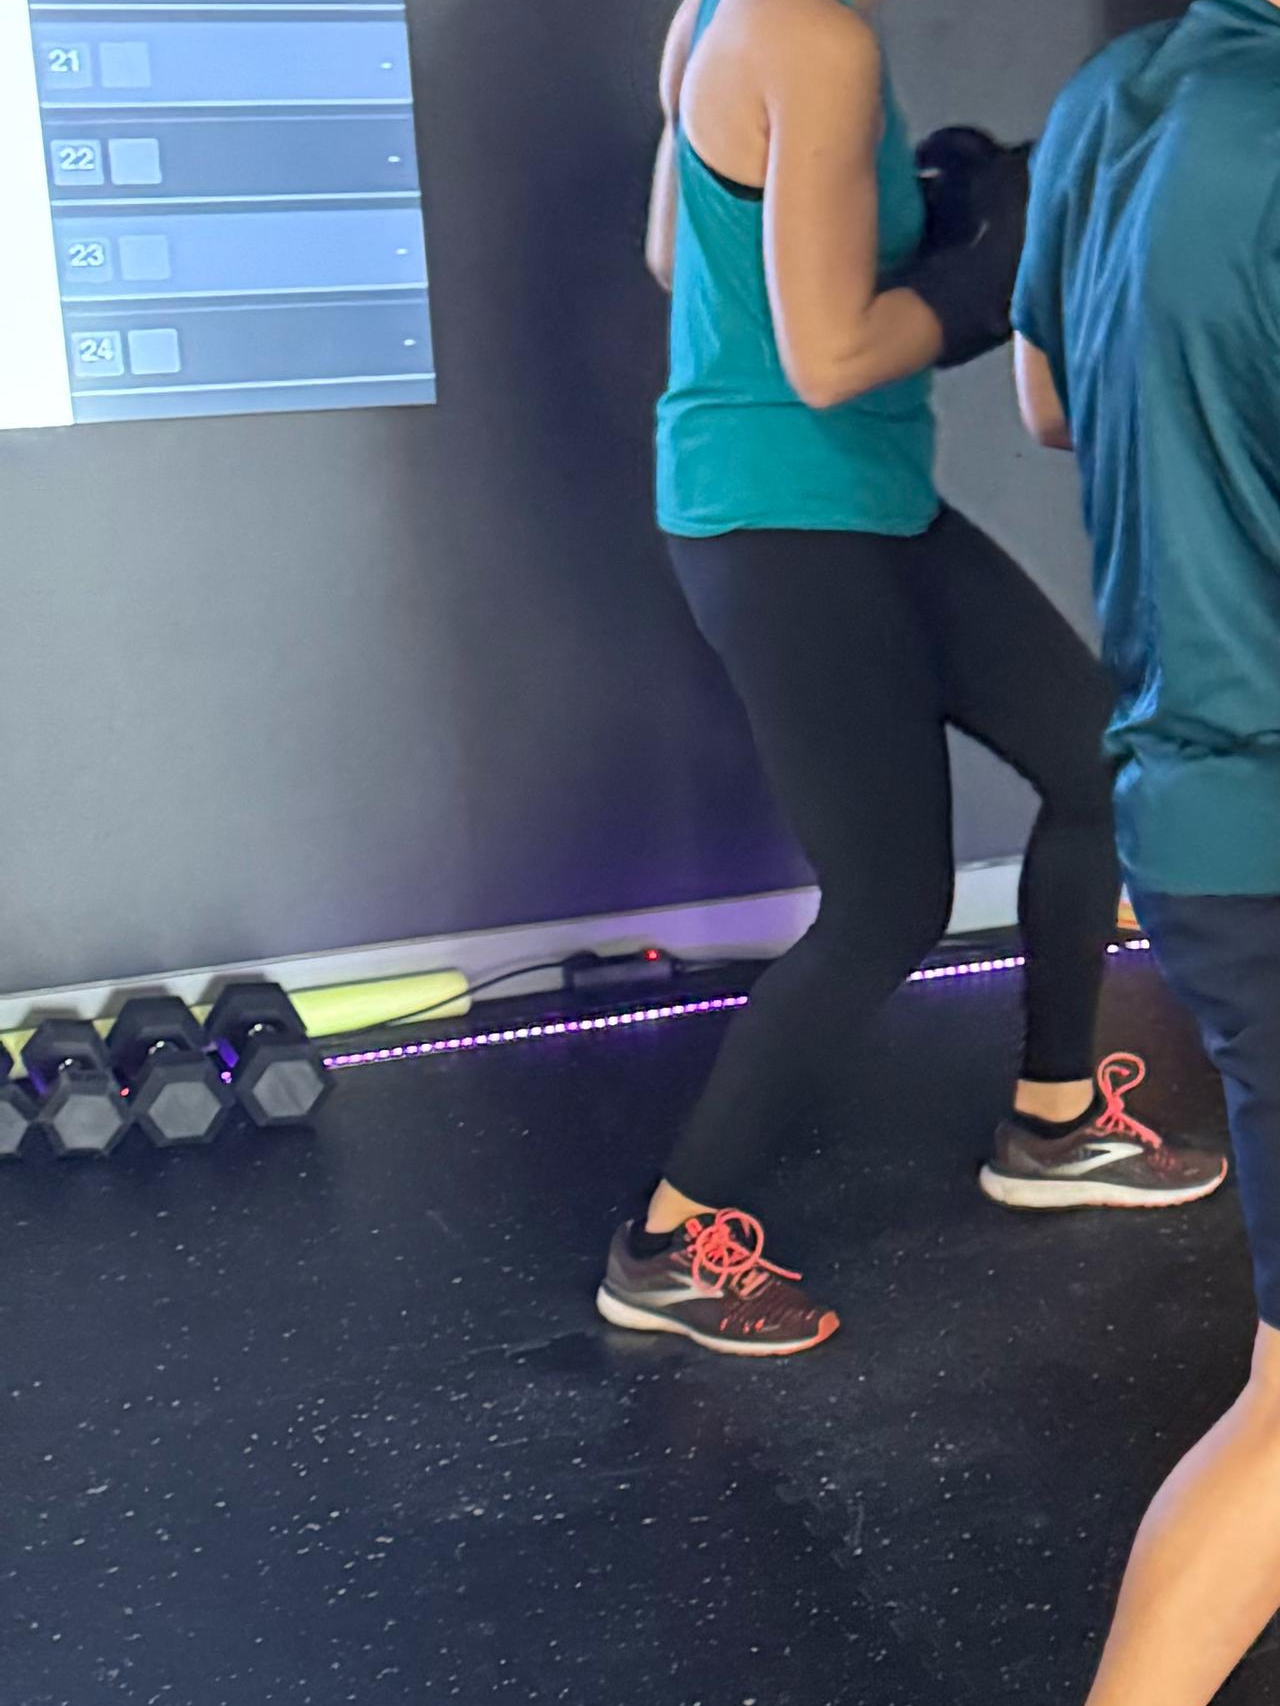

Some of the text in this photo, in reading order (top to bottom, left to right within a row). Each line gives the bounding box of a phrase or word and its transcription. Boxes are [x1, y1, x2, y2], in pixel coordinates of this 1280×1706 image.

[48, 48, 81, 73] 21
[59, 146, 95, 172] 22
[68, 243, 105, 269] 23
[79, 338, 115, 363] 24
